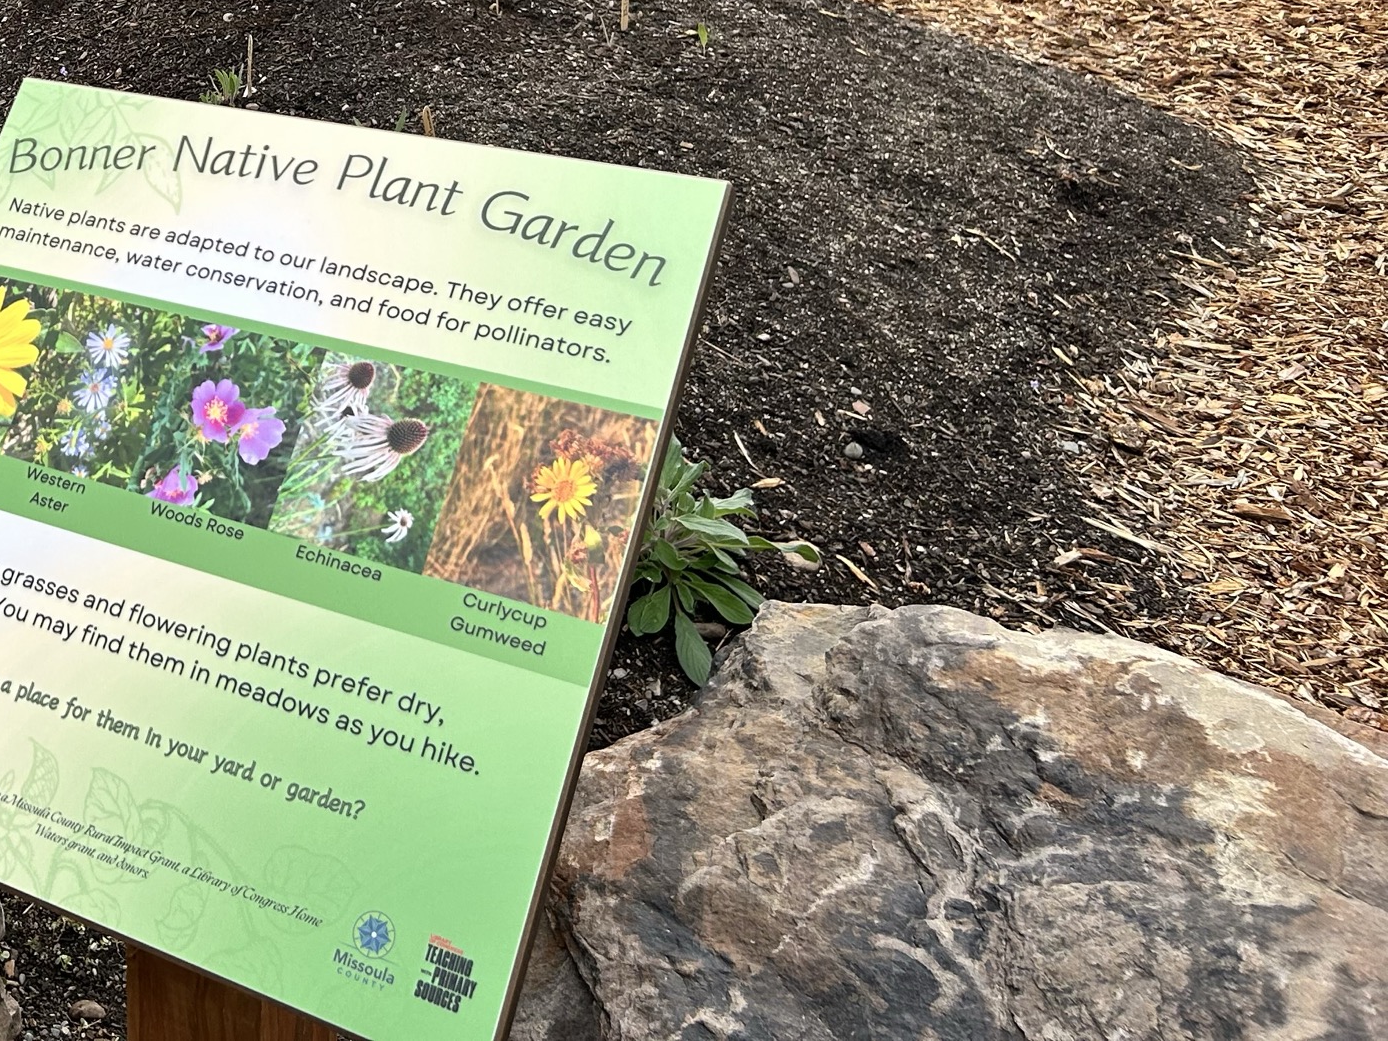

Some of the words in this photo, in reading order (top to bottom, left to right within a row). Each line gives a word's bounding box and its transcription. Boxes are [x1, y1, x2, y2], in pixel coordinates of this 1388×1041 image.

[9, 137, 156, 174] Bonner
[173, 135, 318, 185] Native
[336, 154, 463, 216] Plant
[481, 190, 666, 287] Garden
[9, 198, 65, 221] Native
[67, 209, 126, 233] plants
[129, 223, 161, 240] are
[165, 229, 250, 258] adapted
[254, 245, 275, 263] to
[280, 252, 316, 273] our
[320, 256, 438, 296] landscape.
[448, 281, 503, 310] They
[508, 295, 569, 320] offer
[573, 309, 633, 337] easy
[127, 251, 183, 274] water
[186, 262, 324, 306] conservation,
[330, 290, 373, 313] and
[378, 298, 432, 326] food
[437, 310, 471, 333] for
[474, 321, 611, 364] pollinators.
[27, 466, 86, 494] Western
[29, 491, 69, 513] Aster
[150, 501, 203, 528] Woods
[206, 517, 244, 540] Rose
[295, 545, 383, 581] Echinacea
[462, 592, 547, 630] Curlycup
[1, 568, 79, 603] grasses
[83, 594, 125, 618] and
[130, 604, 232, 657] flowering
[235, 642, 310, 679] plants
[313, 667, 393, 705] prefer
[398, 692, 444, 727] dry,
[450, 616, 546, 656] Gumweed
[33, 611, 78, 642] may
[82, 624, 125, 654] find
[128, 642, 185, 675] them
[189, 660, 210, 685] in
[215, 675, 330, 724] meadows
[336, 713, 364, 735] as
[367, 724, 415, 753] you
[421, 736, 480, 776] hike.
[0, 679, 12, 694] a
[14, 681, 60, 710] place
[61, 697, 92, 722] for
[96, 709, 141, 740] them
[164, 738, 208, 764] your
[210, 755, 257, 782] yard
[260, 772, 282, 790] or
[285, 787, 366, 820] garden?
[0, 794, 7, 803] a
[6, 794, 51, 819] Missoula
[50, 811, 85, 833] County
[84, 824, 114, 845] Rural
[111, 834, 151, 858] Impact
[182, 867, 189, 875] a
[189, 867, 231, 892] Library
[230, 885, 244, 897] of
[242, 887, 289, 914] Congress
[287, 902, 323, 928] Home
[34, 823, 68, 846] Waters
[97, 851, 119, 865] and
[333, 948, 395, 985] Missoula
[337, 967, 385, 992] COUNTY
[425, 943, 474, 978] TEACHING
[414, 979, 462, 1014] SOURCES
[431, 966, 478, 999] PRIMARY
